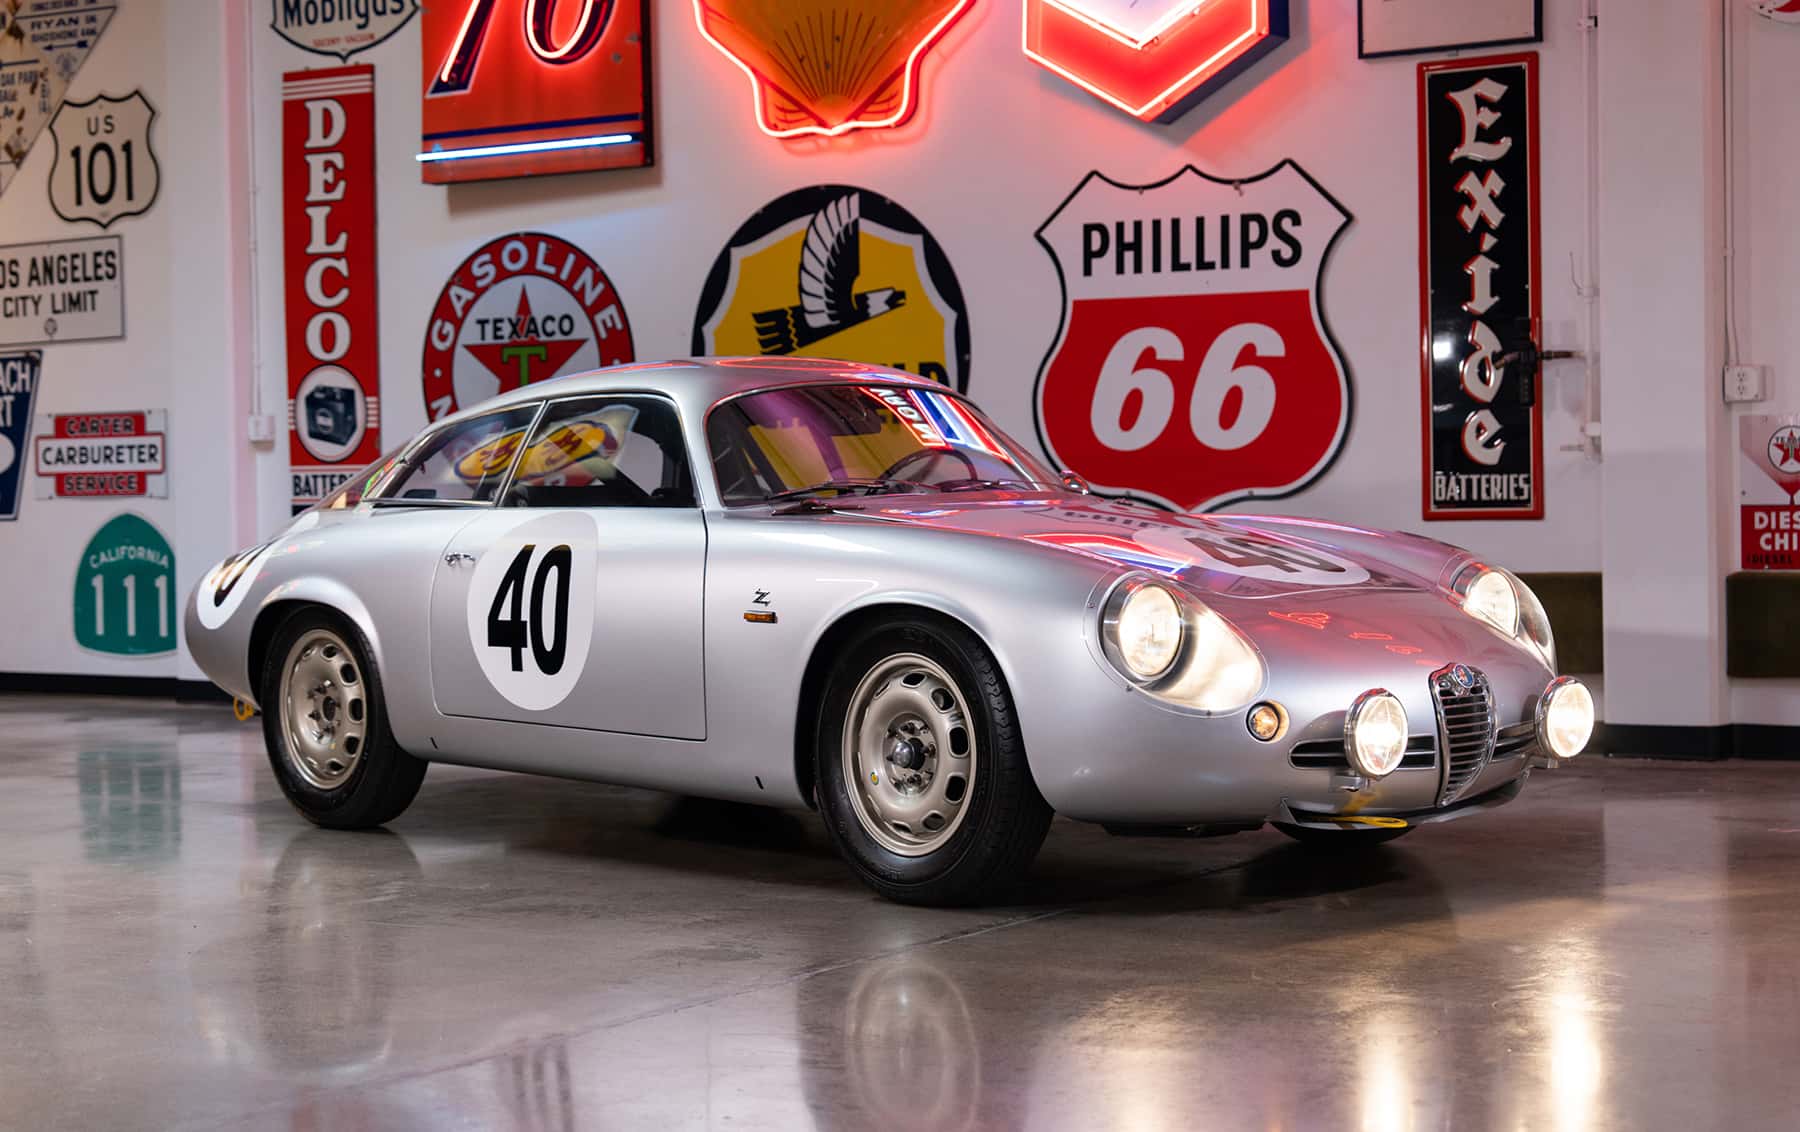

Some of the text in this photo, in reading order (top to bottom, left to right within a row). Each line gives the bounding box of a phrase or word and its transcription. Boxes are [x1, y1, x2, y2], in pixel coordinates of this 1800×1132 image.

[86, 114, 116, 136] US
[70, 140, 135, 206] 101
[304, 98, 352, 362] DELCO
[1082, 208, 1303, 277] PHILLIPS
[27, 249, 117, 287] ANGELES
[1445, 77, 1513, 466] Exide
[3, 289, 99, 318] CITY LIMIT
[430, 239, 625, 351] GASOLINE
[476, 313, 575, 341] TEXACO
[1090, 322, 1287, 452] 66
[66, 418, 135, 435] CARTER
[42, 443, 159, 465] CARBURETER
[64, 475, 137, 491] SERVICE
[1434, 473, 1530, 501] BATTERIES
[89, 546, 170, 569] CALIFORNIA
[1759, 531, 1799, 552] CHI
[91, 574, 169, 638] 111
[487, 543, 573, 676] 40
